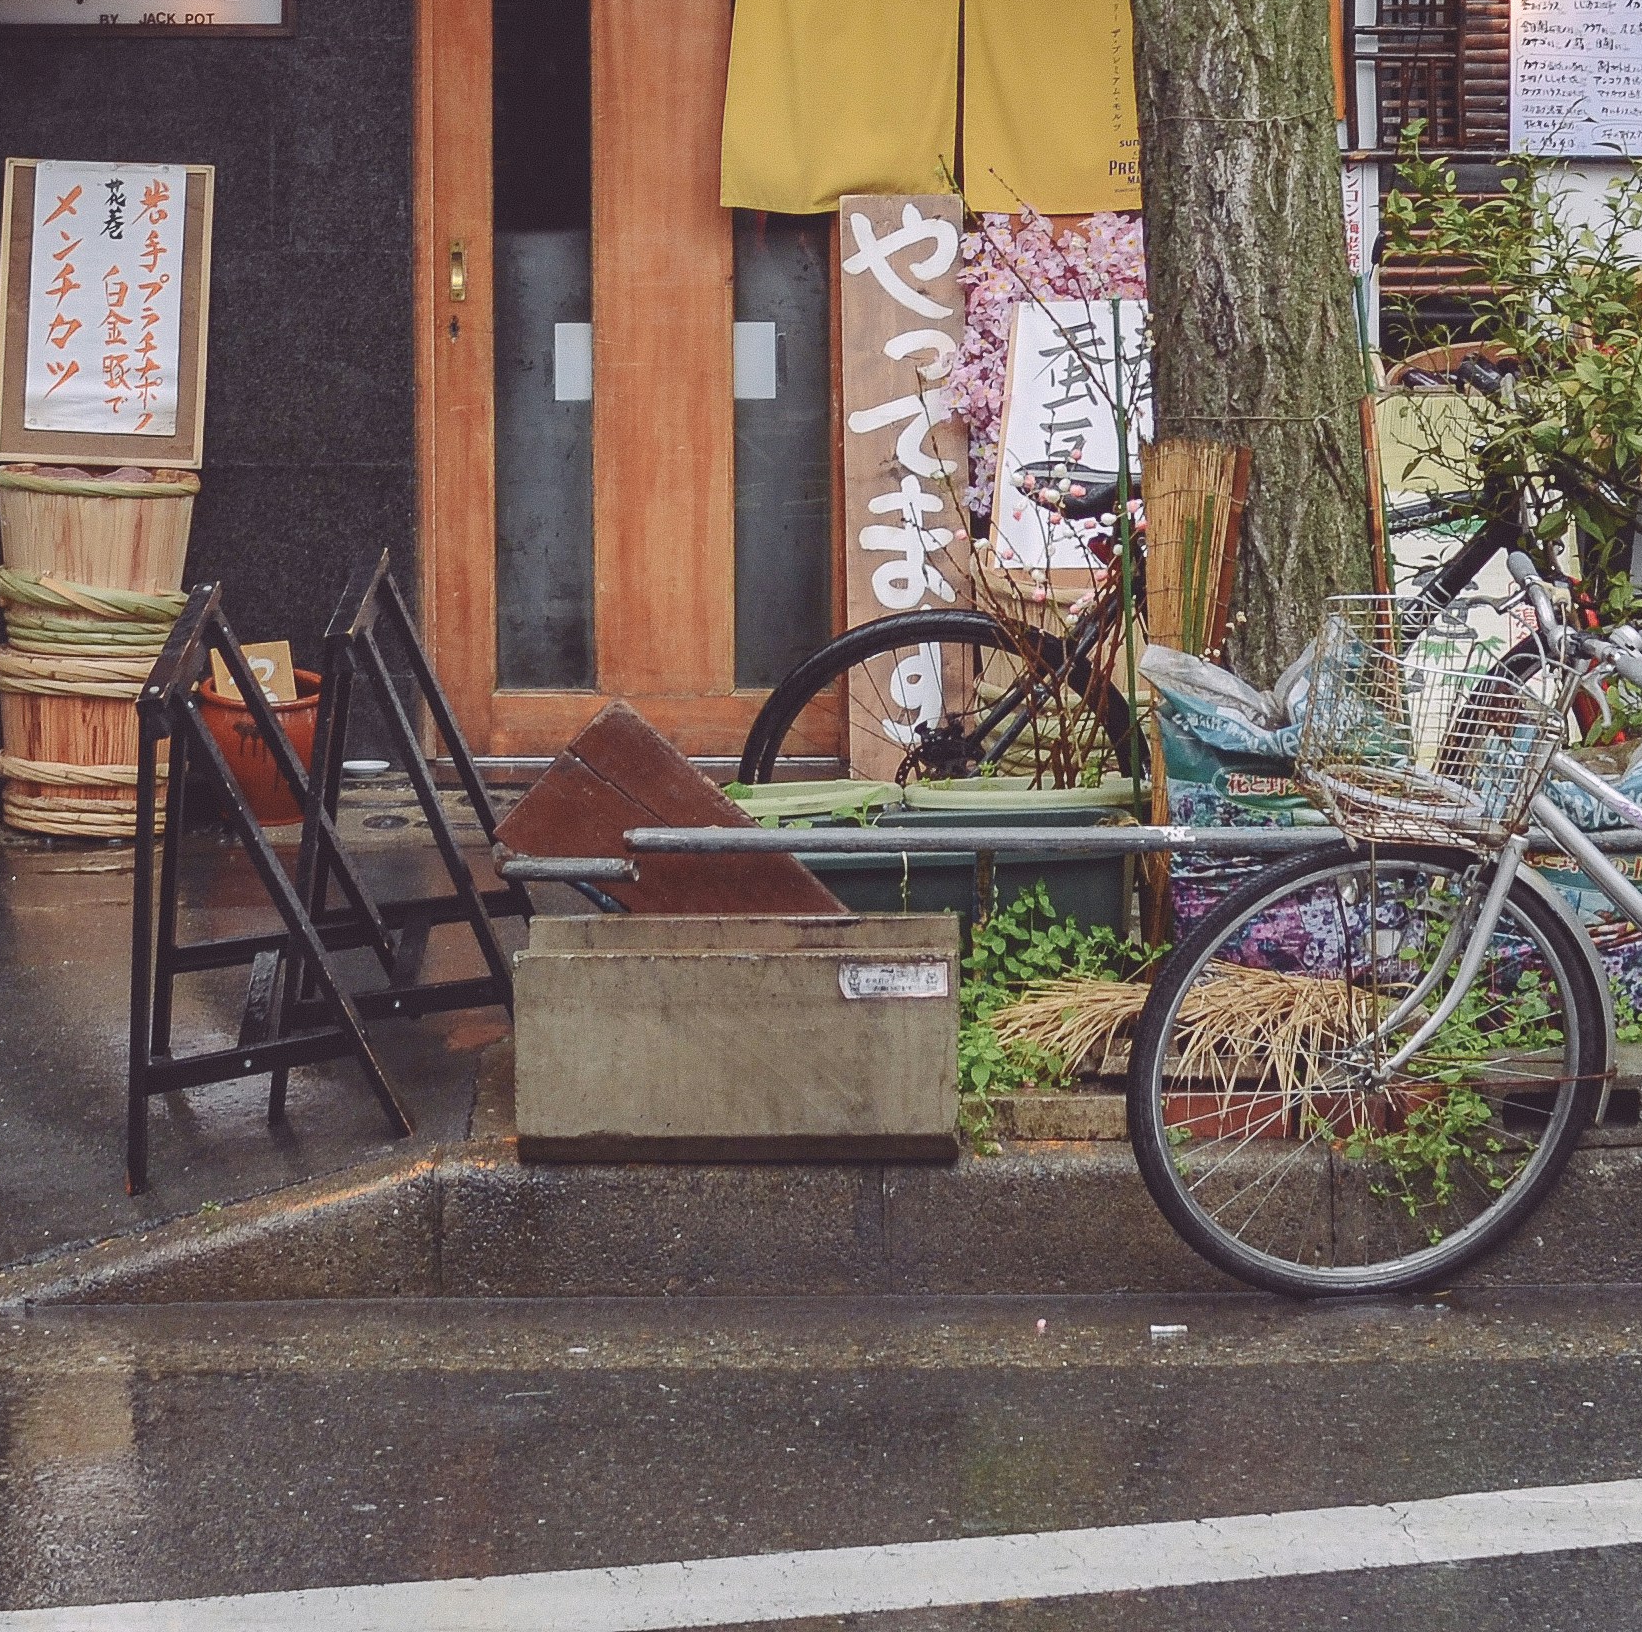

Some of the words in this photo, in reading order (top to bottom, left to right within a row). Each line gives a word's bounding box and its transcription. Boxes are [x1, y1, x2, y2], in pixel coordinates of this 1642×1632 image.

[138, 11, 176, 25] JACK
[184, 13, 215, 25] POT
[99, 178, 128, 241] 花巻
[42, 184, 84, 400] メンチカツ
[1228, 772, 1301, 798] 花と野
